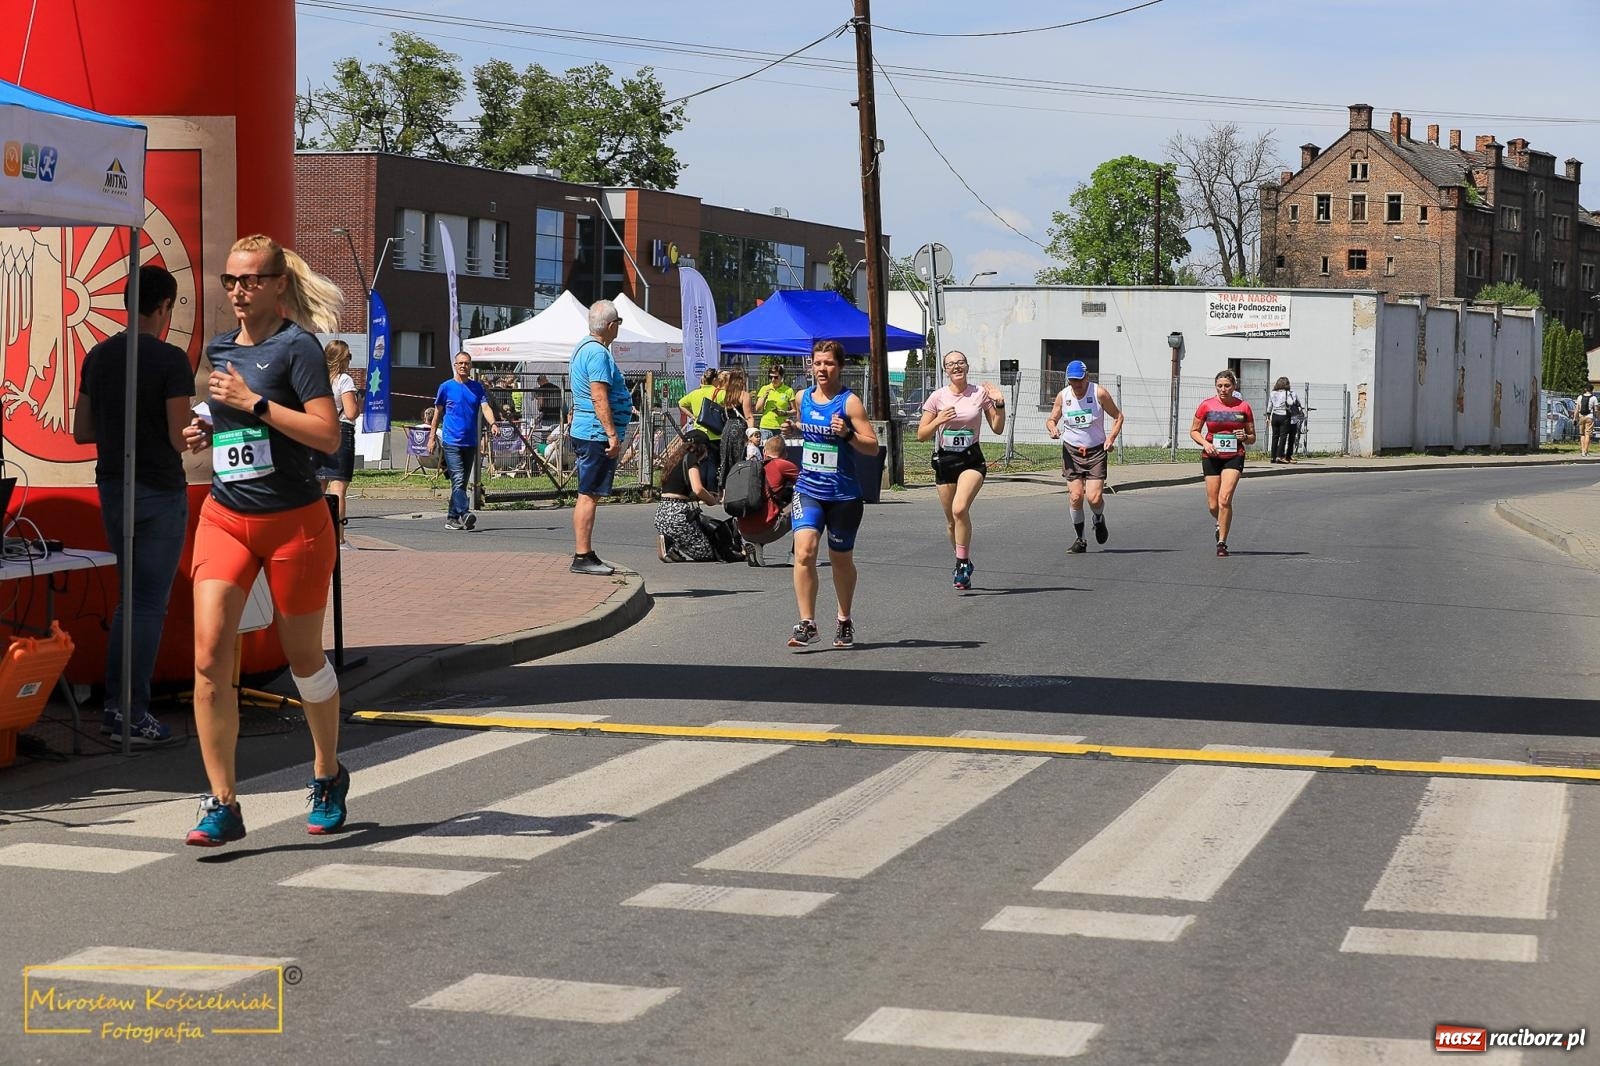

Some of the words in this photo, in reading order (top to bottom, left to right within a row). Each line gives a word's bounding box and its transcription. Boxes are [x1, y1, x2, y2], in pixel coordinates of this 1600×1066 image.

[105, 172, 128, 190] MITKO
[1218, 293, 1245, 303] TRWA
[1209, 302, 1236, 312] Sekcja
[1238, 303, 1287, 312] Podnoszenia
[1209, 310, 1244, 320] Ciężarów
[1075, 415, 1086, 424] 93
[953, 436, 965, 446] 81
[1220, 439, 1231, 448] 92
[228, 445, 255, 467] 96
[812, 452, 825, 465] 91
